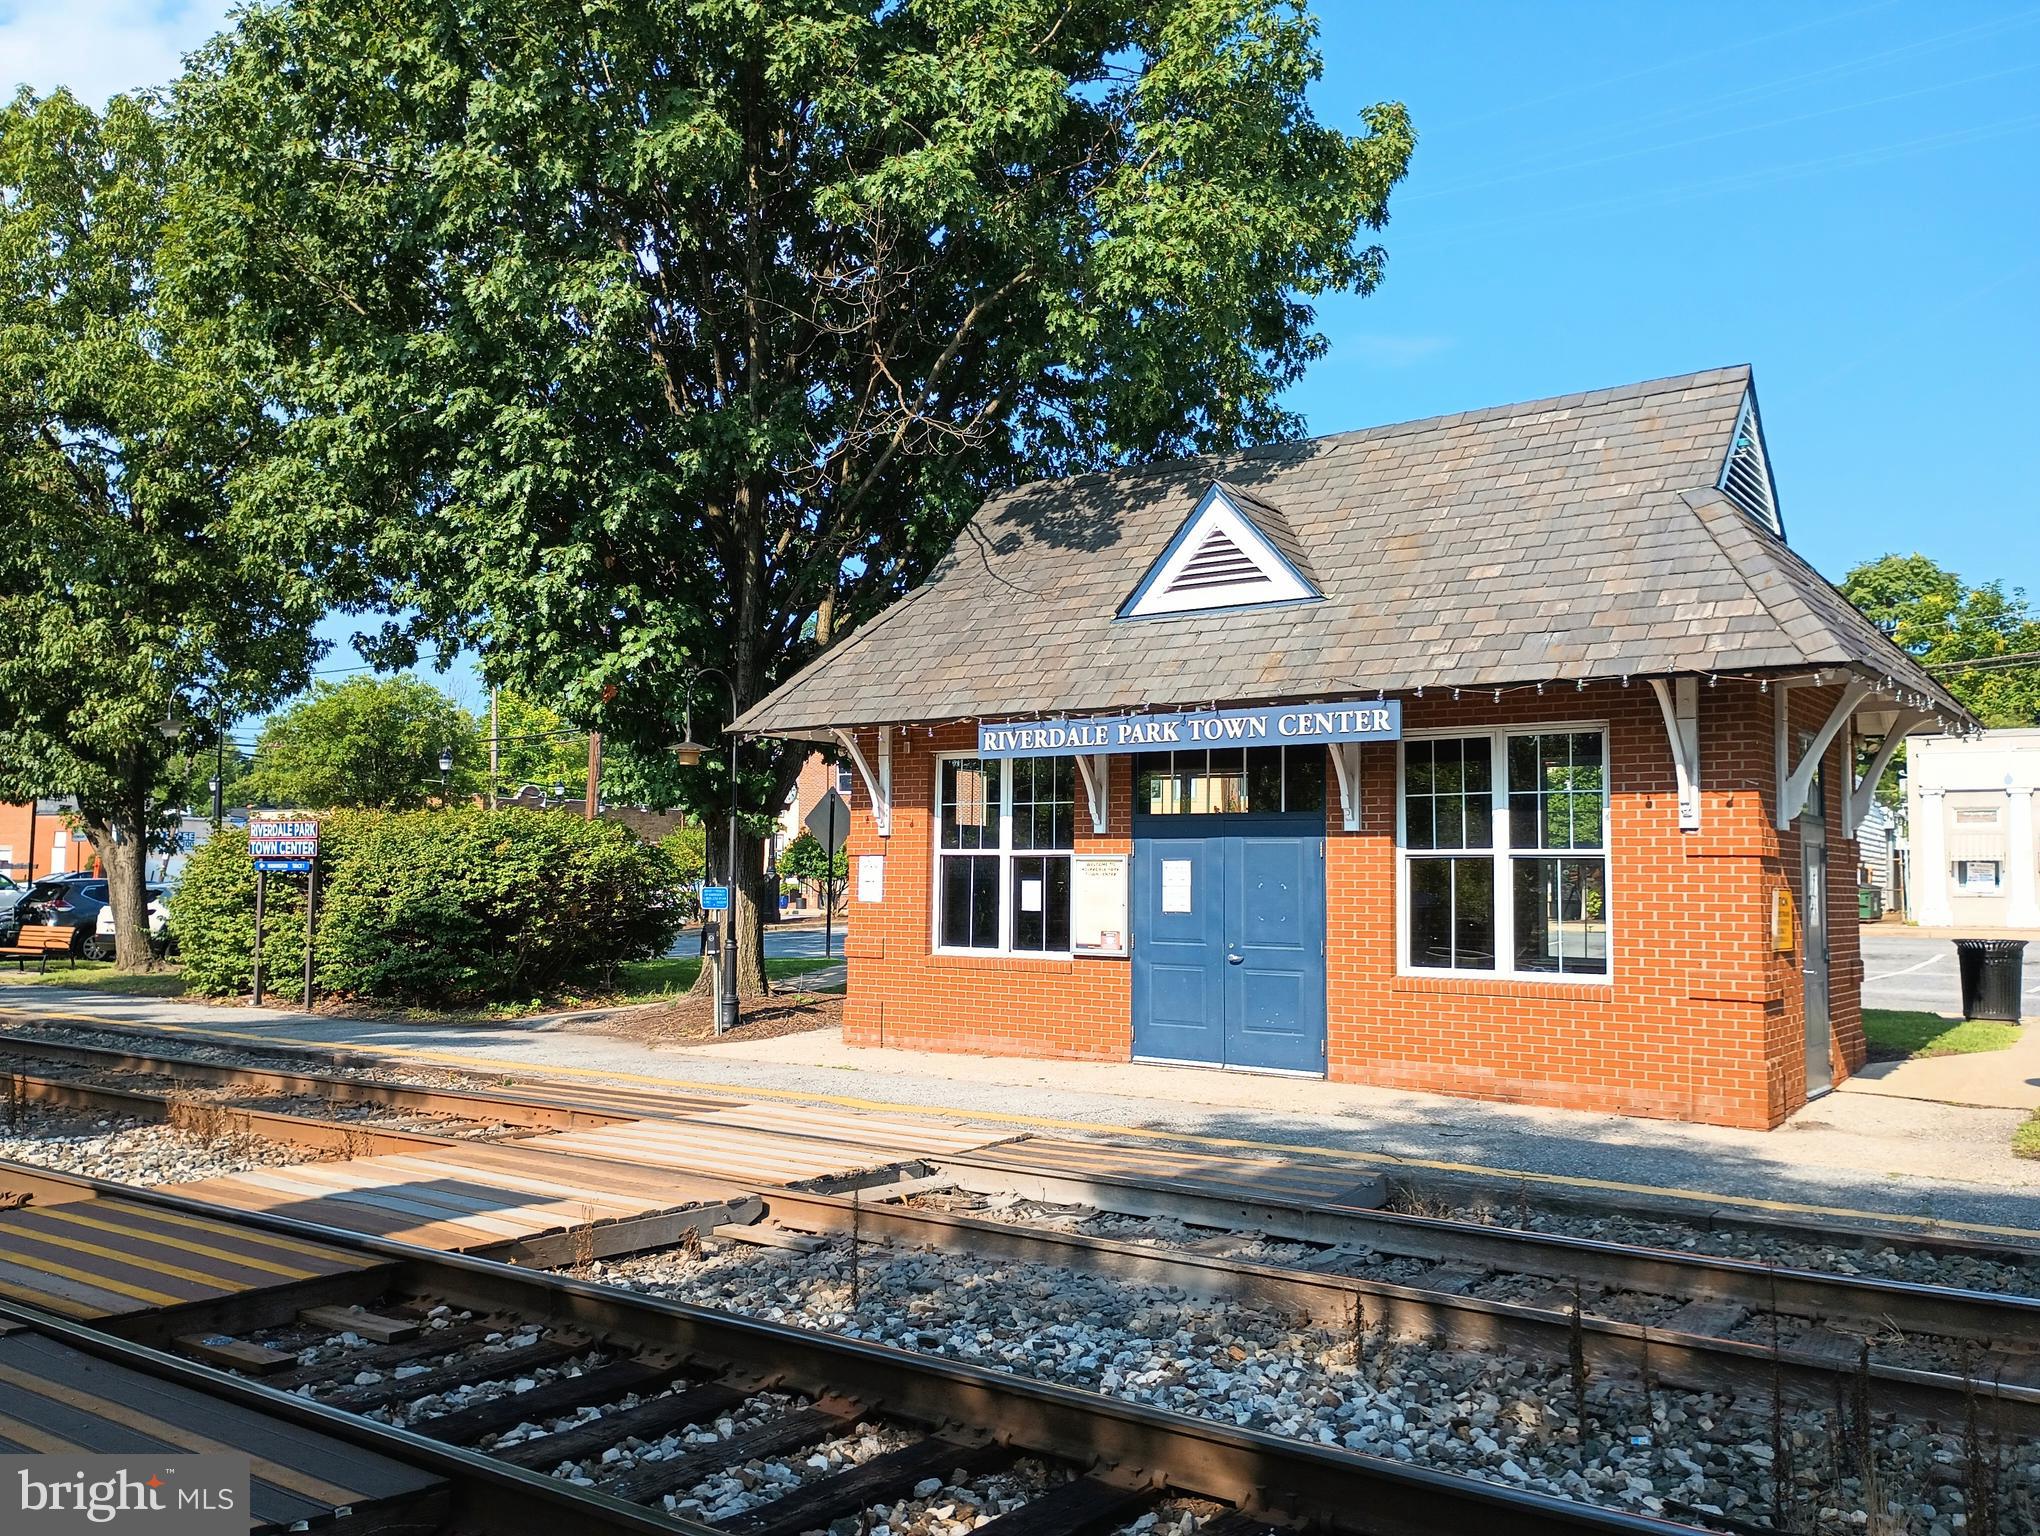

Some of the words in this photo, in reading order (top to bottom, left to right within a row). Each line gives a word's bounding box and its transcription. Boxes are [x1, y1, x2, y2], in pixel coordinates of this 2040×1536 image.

[983, 725, 1109, 752] RIVERDALE
[1117, 721, 1181, 746] PARK
[1187, 715, 1269, 741] TOWN
[1278, 708, 1393, 737] CENTER
[250, 822, 293, 837] RIVERDALE
[294, 822, 316, 837] PARK
[250, 841, 278, 855] TOWN
[279, 841, 315, 855] CENTER
